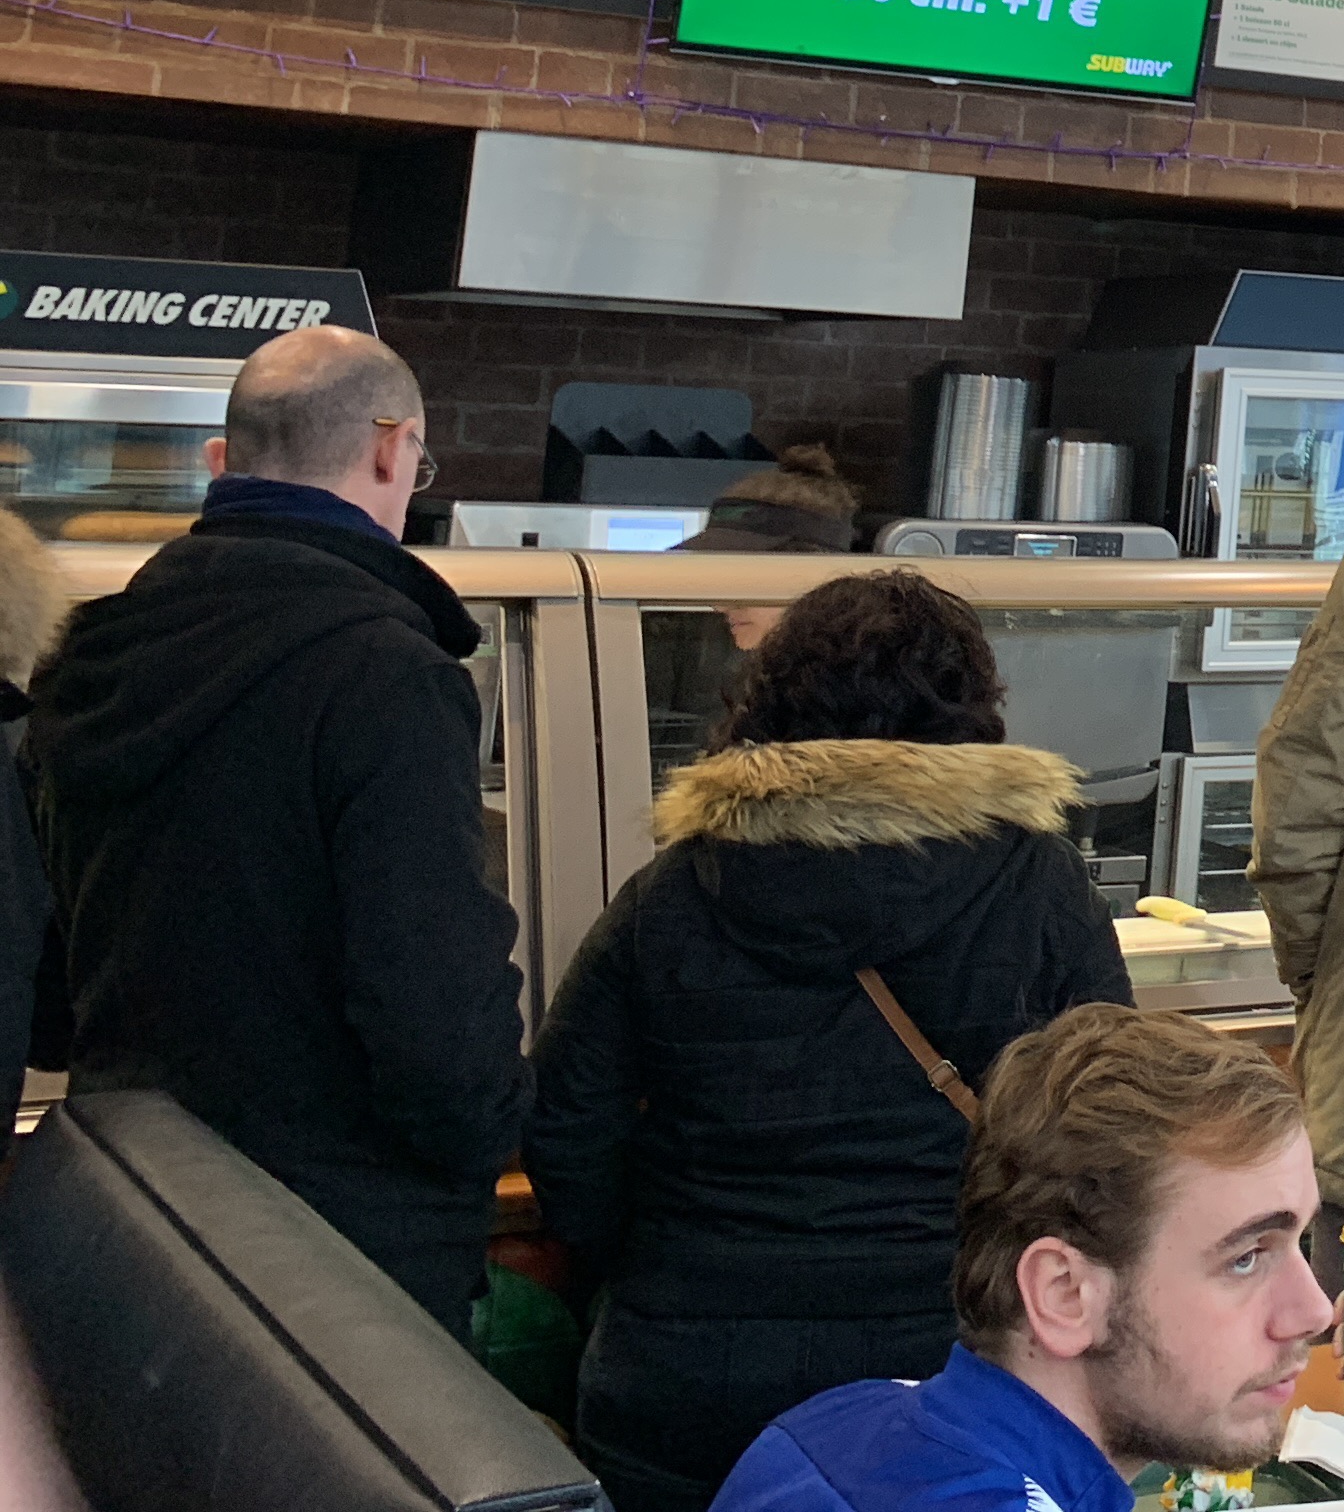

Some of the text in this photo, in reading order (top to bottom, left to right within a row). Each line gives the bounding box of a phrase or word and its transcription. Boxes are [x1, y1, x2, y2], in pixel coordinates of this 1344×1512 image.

[1086, 53, 1170, 79] SUBWAY
[24, 285, 331, 330] BAKING CENTER
